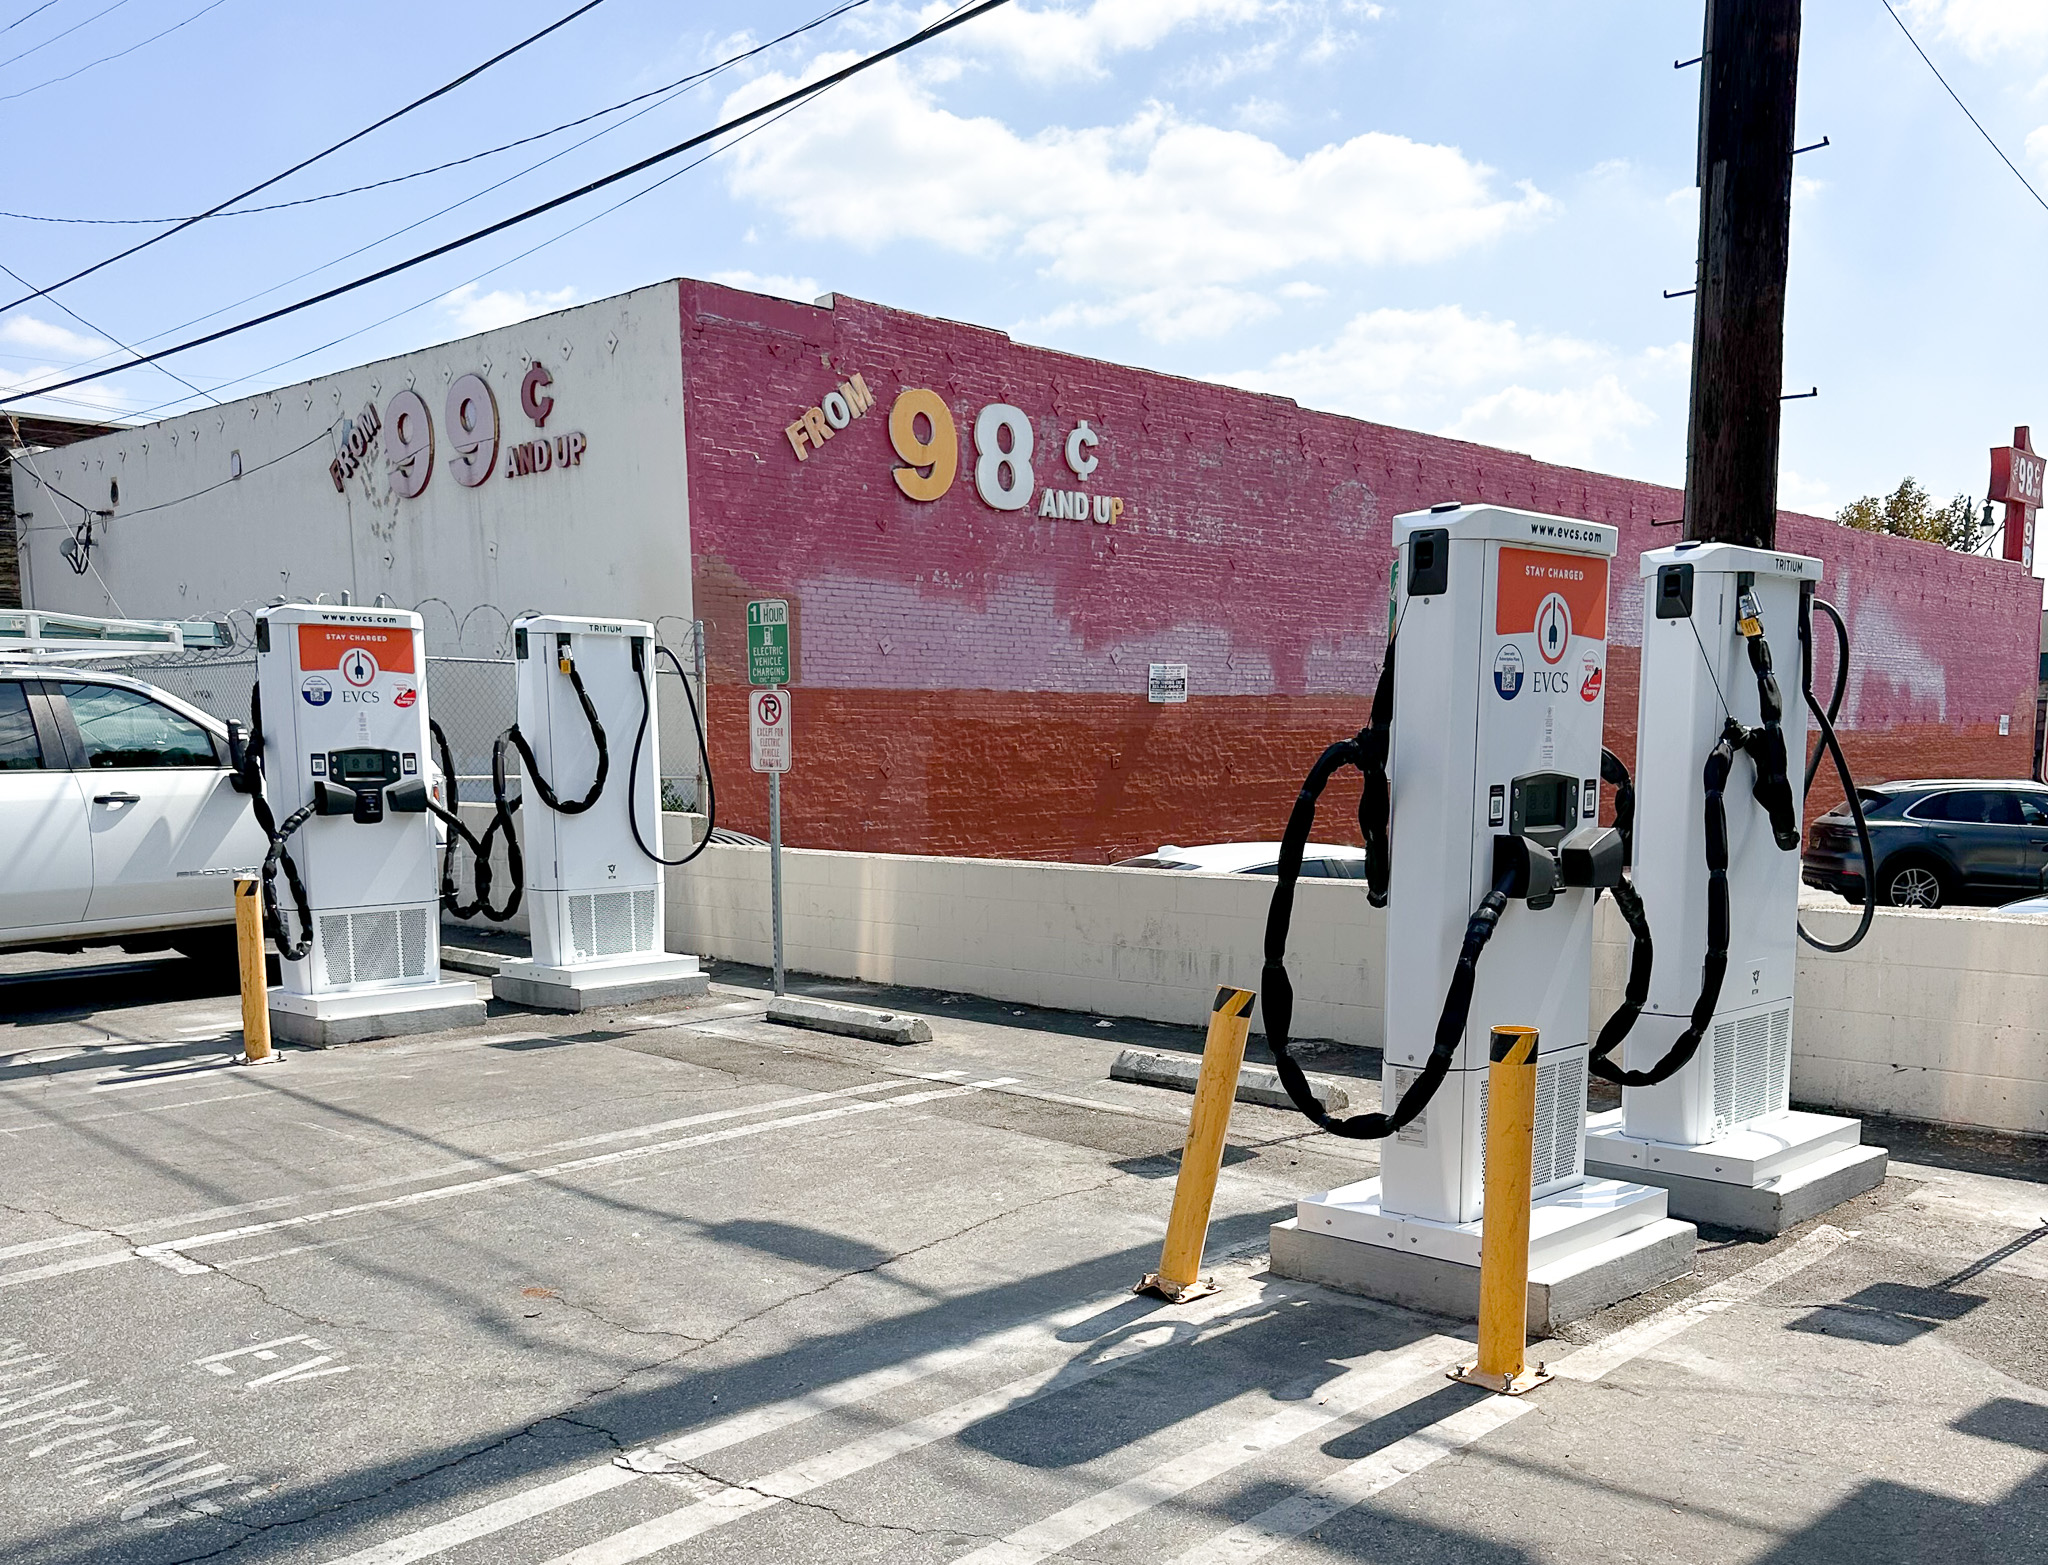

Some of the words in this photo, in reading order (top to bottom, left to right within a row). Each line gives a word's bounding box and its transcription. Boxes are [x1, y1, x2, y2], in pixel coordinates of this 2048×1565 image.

[785, 372, 875, 462] FROM
[329, 401, 381, 493] FROM
[505, 440, 552, 478] AND
[553, 432, 587, 468] UP
[1038, 488, 1089, 521] AND
[1093, 495, 1124, 525] UP
[1531, 524, 1602, 542] www.evcs.com
[1775, 558, 1803, 573] TRITIUM
[1525, 565, 1545, 577] STAY
[1548, 568, 1584, 580] CHARGED
[322, 614, 397, 624] www.evcs.com
[750, 605, 757, 622] 1
[763, 607, 784, 622] HOUR
[589, 625, 622, 633] TRITIUM
[326, 633, 346, 641] STAY
[753, 646, 783, 656] ELECTRIC
[755, 657, 781, 666] VEHICLE
[752, 667, 785, 677] CHARGING
[1533, 672, 1569, 693] EVCS
[342, 691, 380, 703] EVCS
[757, 728, 773, 737] EXCEPT
[775, 728, 783, 737] FOR
[760, 738, 780, 747] ELECTRIC
[762, 749, 780, 757] VEHICLE
[760, 759, 782, 768] CHARGING
[192, 1333, 352, 1389] EV
